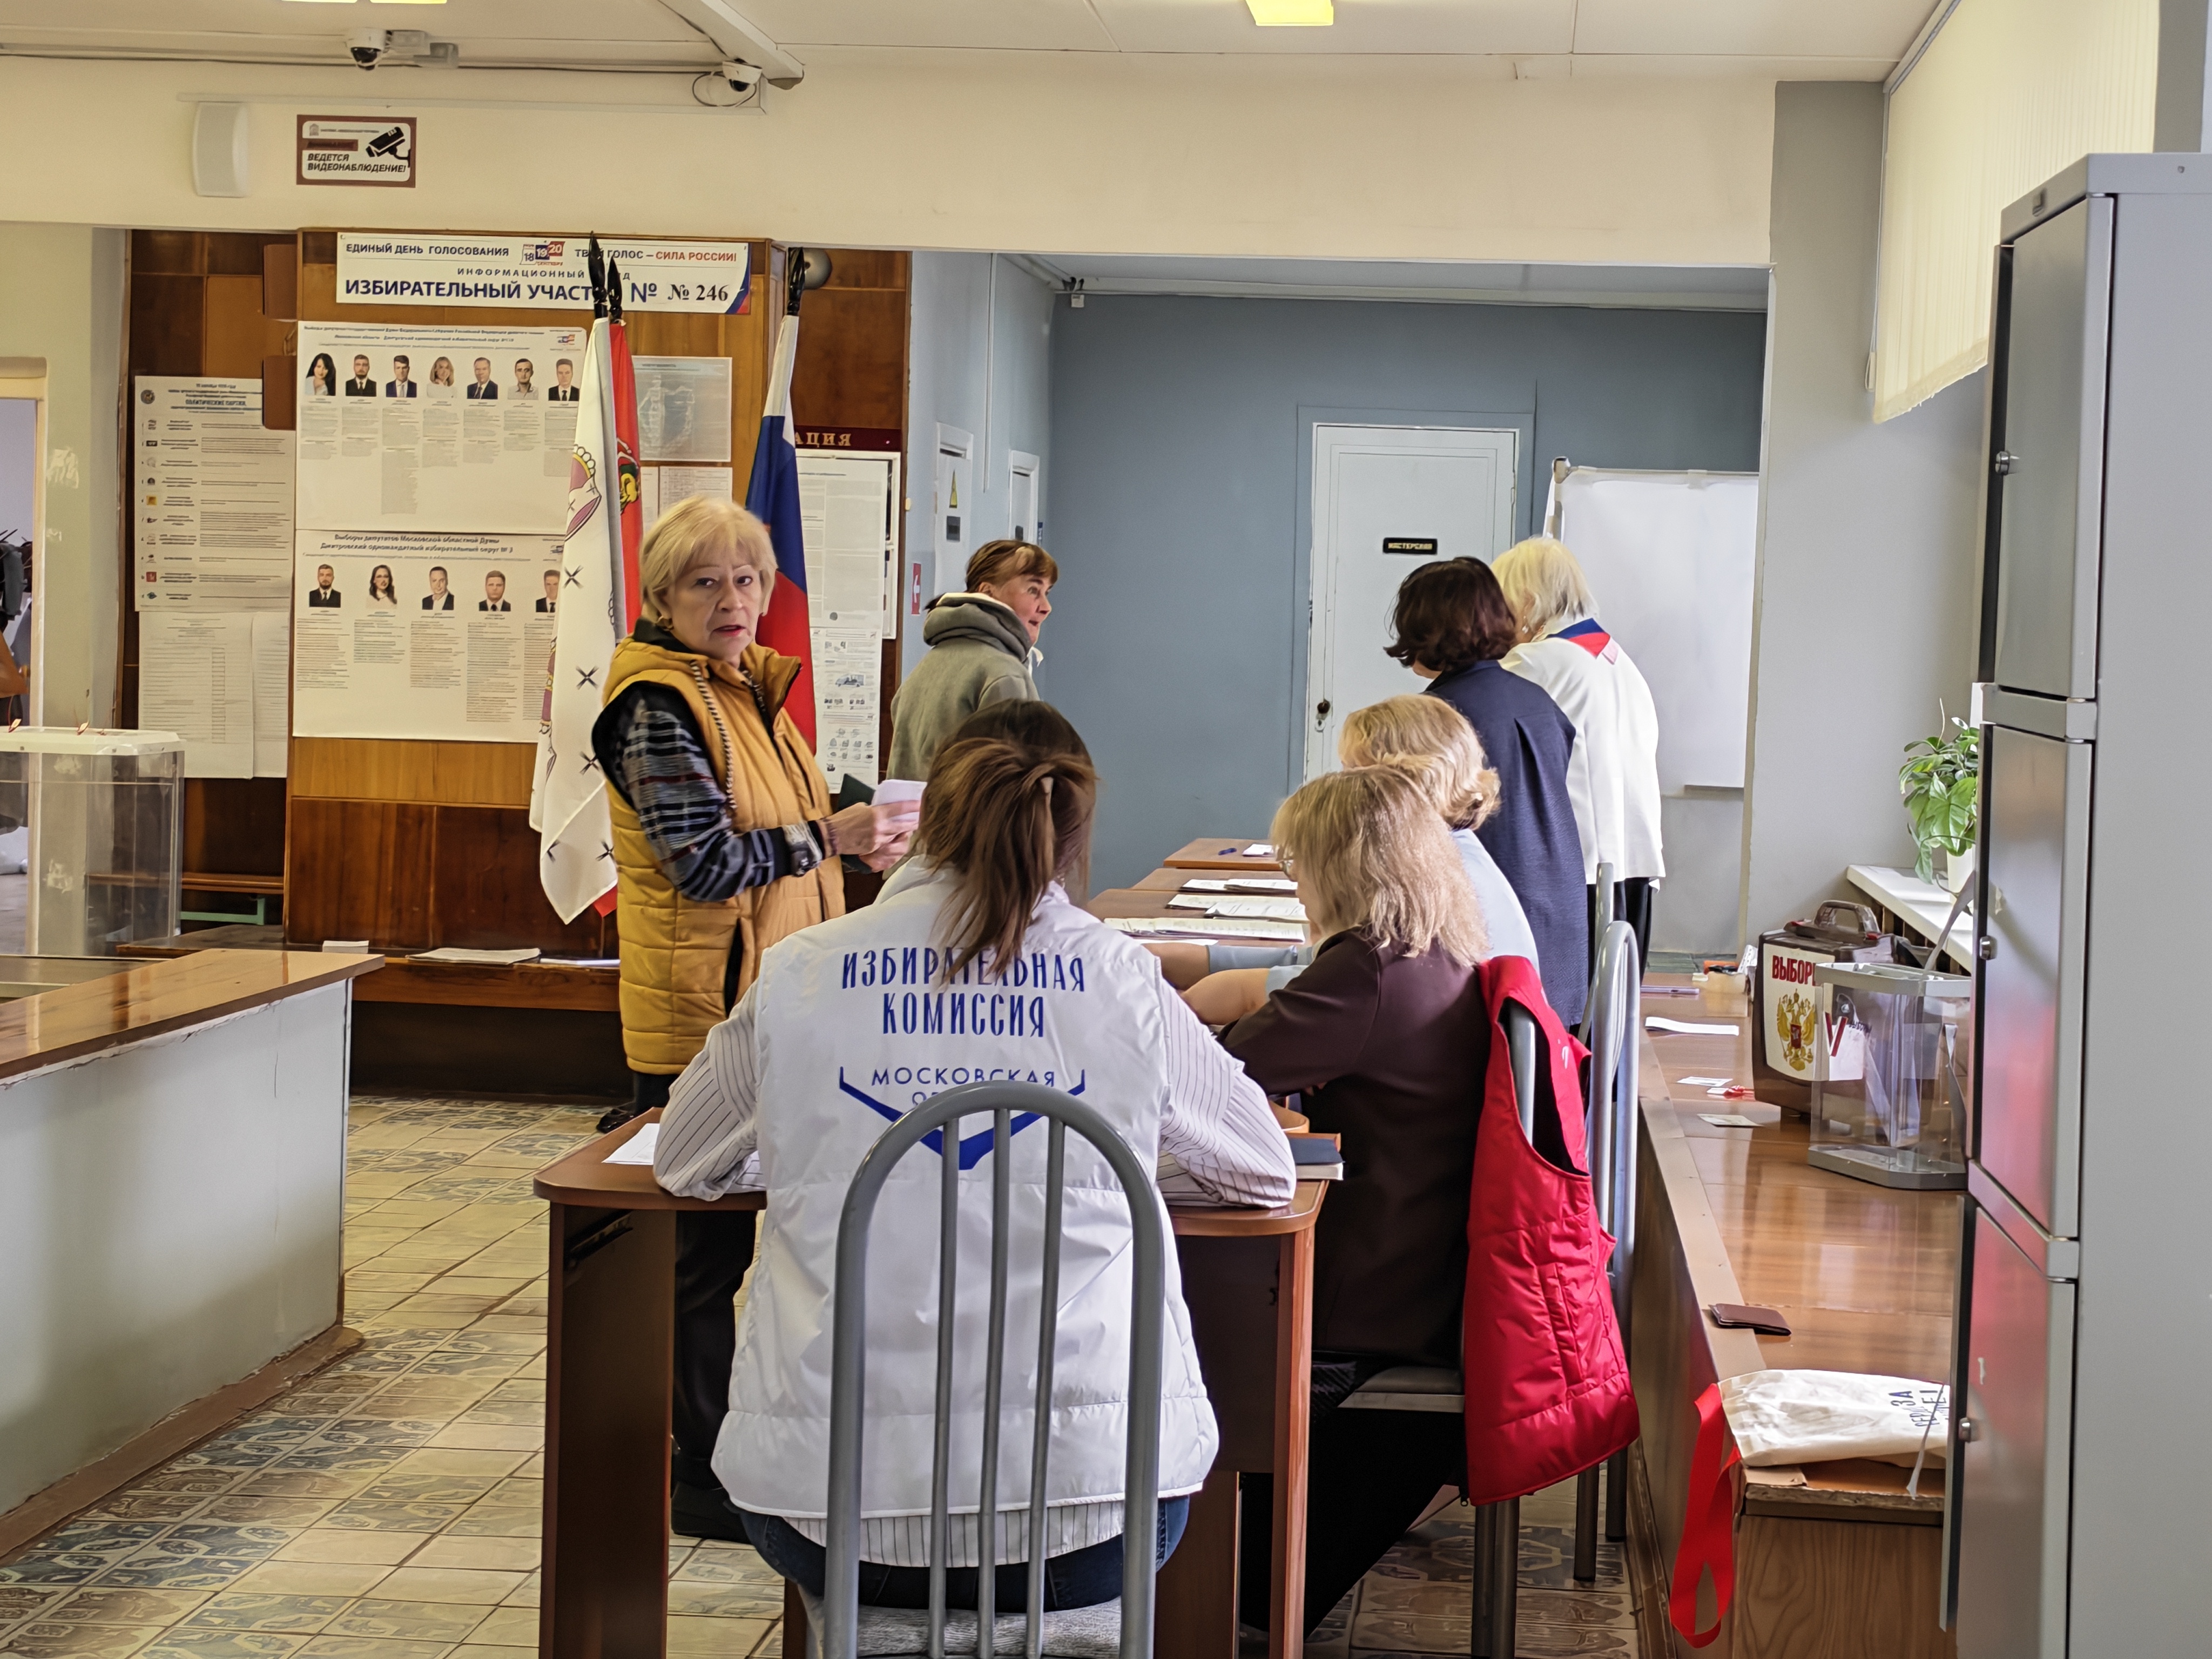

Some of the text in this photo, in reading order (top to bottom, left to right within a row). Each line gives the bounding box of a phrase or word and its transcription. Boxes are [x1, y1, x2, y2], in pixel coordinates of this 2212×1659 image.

[307, 153, 350, 161] ВЕДЕТСЯ
[307, 163, 407, 173] ВИДЕОНАБЛЮДЕНИЕ!
[346, 243, 509, 257] ЕДИНЫЙ ДЕНЬ ГОЛОСОВАНИЯ
[608, 249, 643, 259] ГОЛОС
[656, 252, 685, 261] СИЛА
[689, 252, 737, 262] РОССИИ!
[457, 268, 585, 279] ИНФОРМАЦИОННЫЙ
[346, 280, 521, 299] ИЗБИРАТЕЛЬНЫЙ
[527, 284, 594, 301] УЧАСТ
[667, 284, 690, 300] №
[696, 284, 729, 301] 246
[1772, 955, 1816, 987] ВЫБОР
[882, 992, 1044, 1037] КОМИССИЯ
